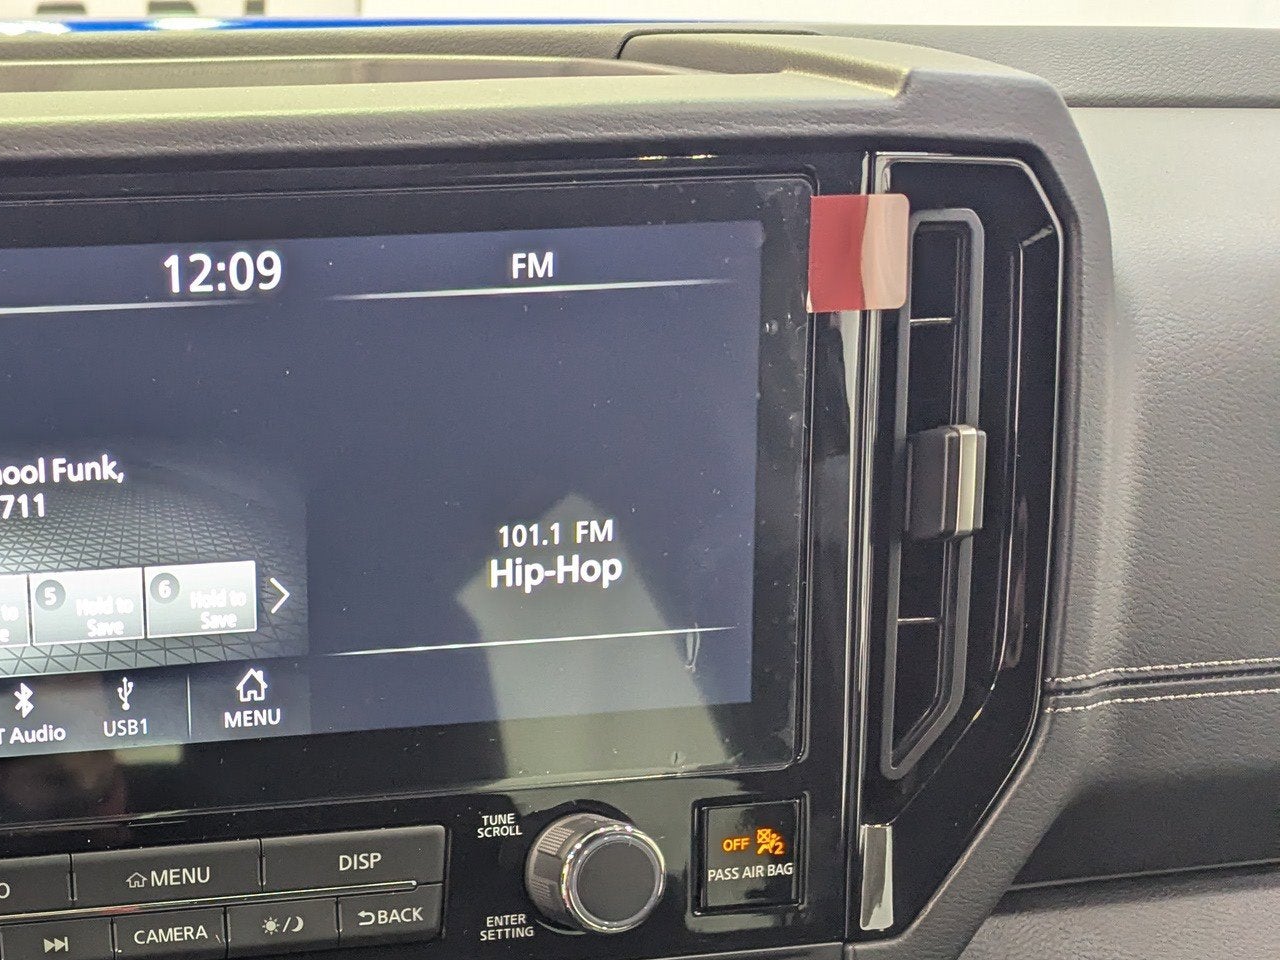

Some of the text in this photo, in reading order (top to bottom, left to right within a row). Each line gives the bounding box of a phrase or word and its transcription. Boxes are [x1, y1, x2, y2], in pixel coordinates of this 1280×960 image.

[163, 250, 283, 294] 12:09
[512, 252, 554, 279] FM
[52, 453, 125, 484] Funk,
[499, 519, 613, 548] 101.1 FM
[489, 553, 622, 594] Hip-Hop
[44, 587, 57, 606] 5
[158, 580, 171, 599] 6
[0, 604, 19, 622] to
[200, 611, 238, 630] Save
[86, 619, 124, 638] Save
[103, 718, 149, 738] USB1
[224, 708, 281, 729] MENU
[9, 723, 67, 745] Audio
[481, 813, 516, 827] TUNE
[477, 824, 523, 840] SCROLL
[722, 836, 751, 853] OFF
[338, 851, 383, 873] DISP
[707, 862, 795, 882] PASS AIR BAG
[150, 866, 211, 888] MENU
[376, 907, 424, 926] BACK
[485, 913, 527, 929] ENTER
[133, 925, 209, 947] CAMERA
[479, 926, 535, 942] SETTING
